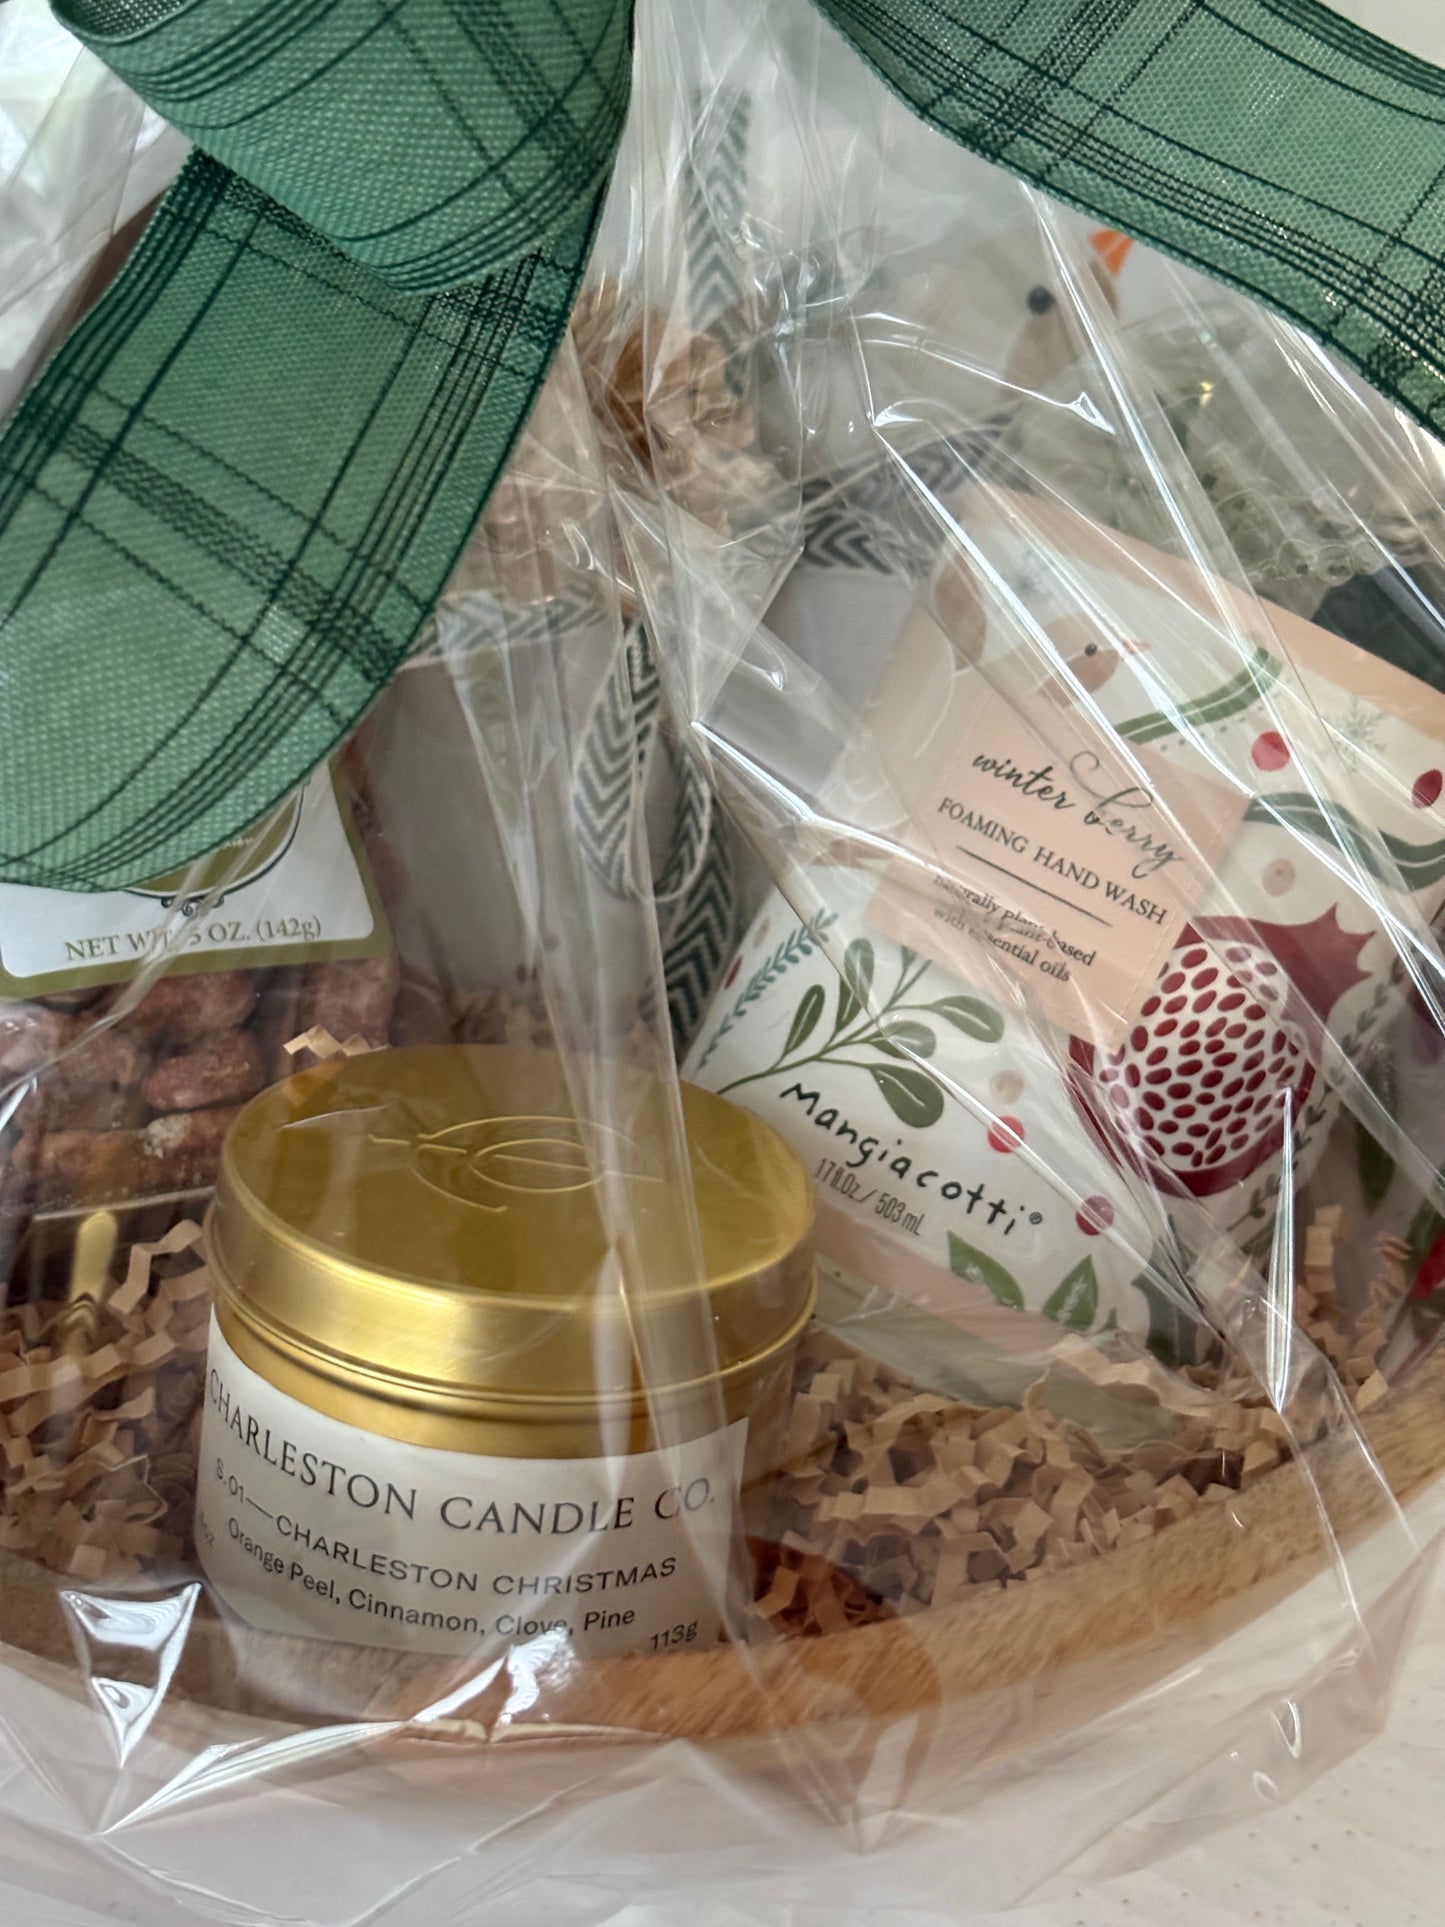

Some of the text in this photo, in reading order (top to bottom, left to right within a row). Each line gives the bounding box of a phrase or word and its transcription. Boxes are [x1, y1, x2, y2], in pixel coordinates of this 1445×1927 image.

[971, 753, 1075, 811] winter
[937, 797, 1168, 927] FOAMING HAND WASH
[64, 934, 120, 961] NET
[256, 915, 322, 942] (142g)
[1040, 961, 1070, 982] oils
[209, 1367, 715, 1535] CHARLESTON CANDLE CO.
[229, 1517, 284, 1573] Orange
[290, 1562, 341, 1604] Peel,
[348, 1588, 486, 1637] Cinnamon,
[496, 1614, 574, 1637] Clove,
[583, 1609, 635, 1631] Pine
[492, 1556, 676, 1596] CHRISTMAS
[651, 1619, 699, 1650] 113g
